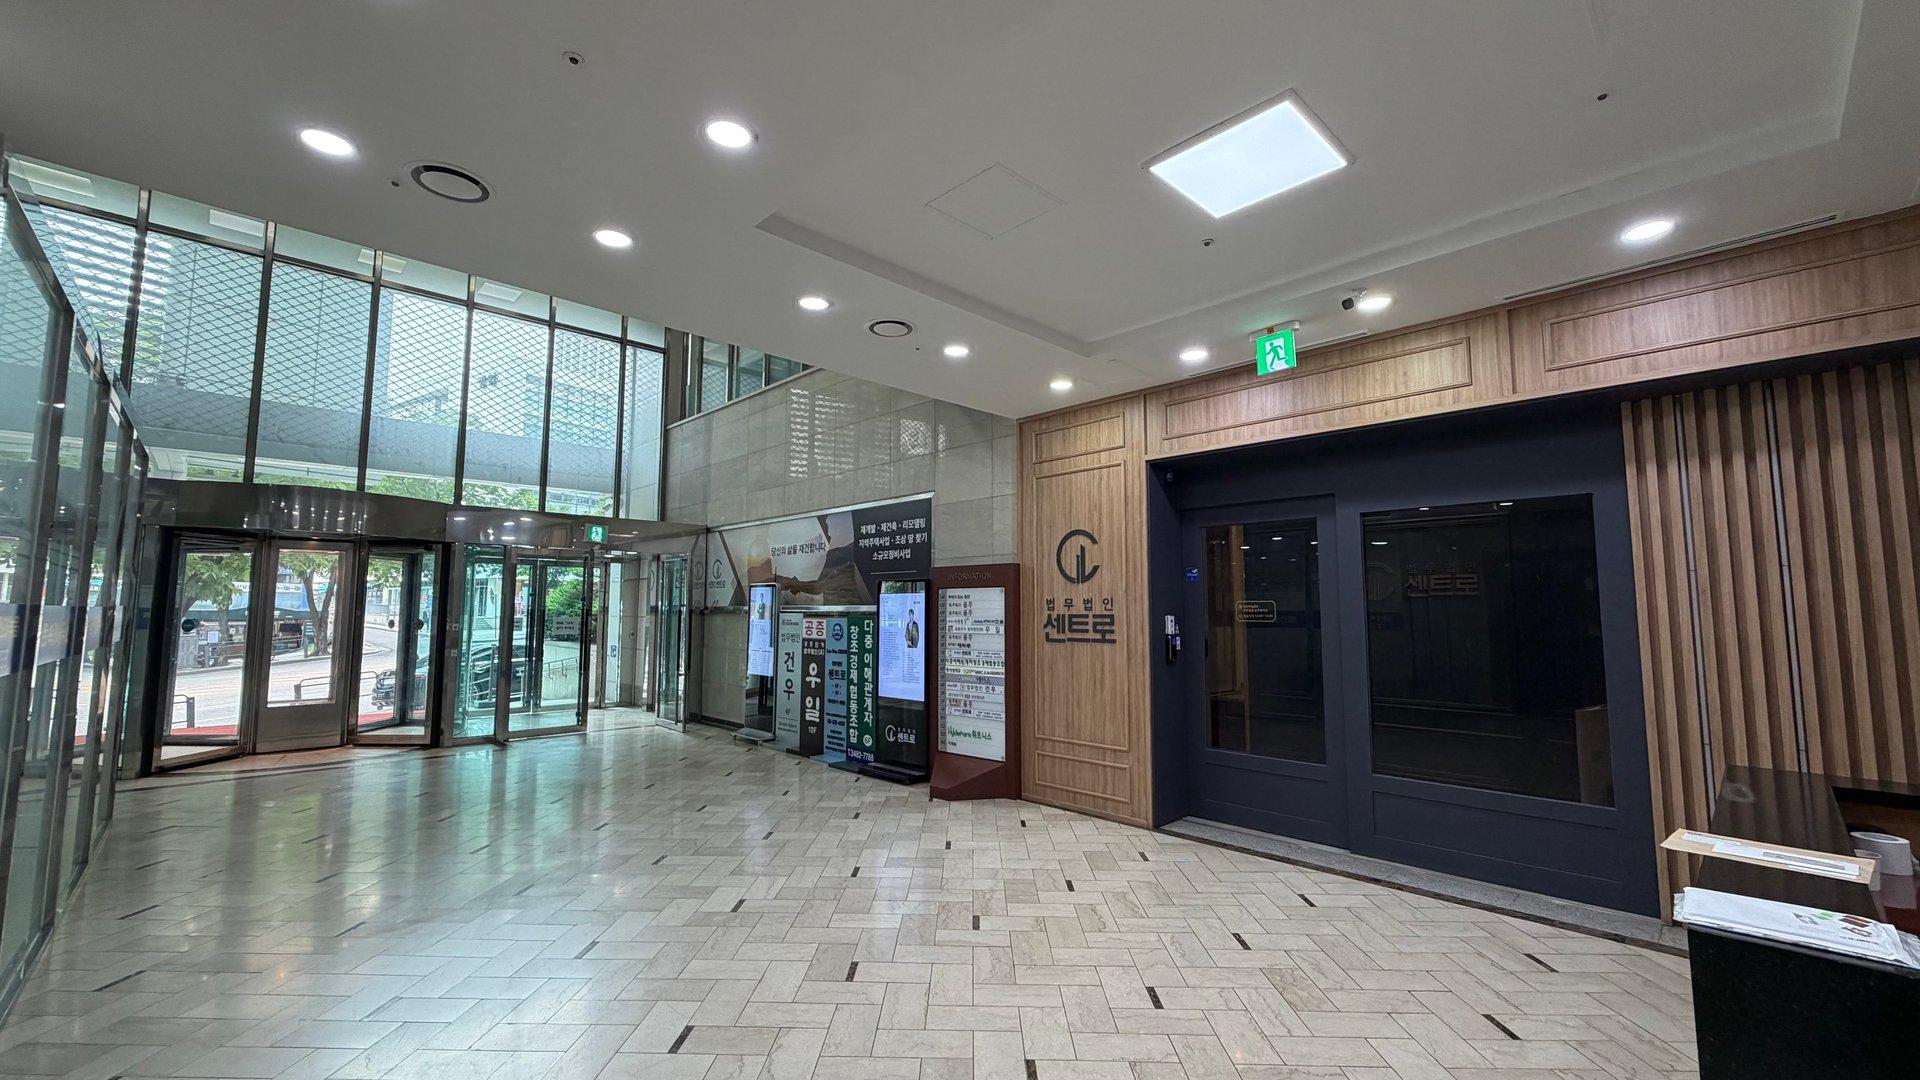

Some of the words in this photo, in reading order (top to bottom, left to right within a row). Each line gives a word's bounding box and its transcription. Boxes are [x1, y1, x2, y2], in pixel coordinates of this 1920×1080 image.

[860, 524, 876, 534] 재개발
[880, 521, 897, 532] 재건축
[902, 518, 926, 529] 리모델링
[859, 536, 890, 548] 지역주택사업
[894, 535, 907, 544] 조상
[908, 533, 914, 543] 땅
[915, 532, 928, 543] 찾기
[771, 545, 786, 556] 당신의
[787, 544, 798, 555] 삶을
[799, 541, 826, 553] 재건합니다
[872, 548, 911, 560] 소규모정비사업
[947, 571, 992, 580] INFORMATION
[1405, 573, 1480, 598] 센트로
[1045, 597, 1114, 612] 법무법인
[804, 620, 826, 637] 공증
[863, 619, 874, 650] 다중
[1043, 613, 1117, 644] 센트로
[783, 651, 796, 701] 건우
[827, 667, 846, 681] 센트로
[805, 662, 821, 723] 우일
[848, 625, 859, 744] 창조경제협동조합
[863, 652, 874, 728] 이해관계자
[808, 725, 818, 735] 10F
[896, 733, 917, 745] 센트로
